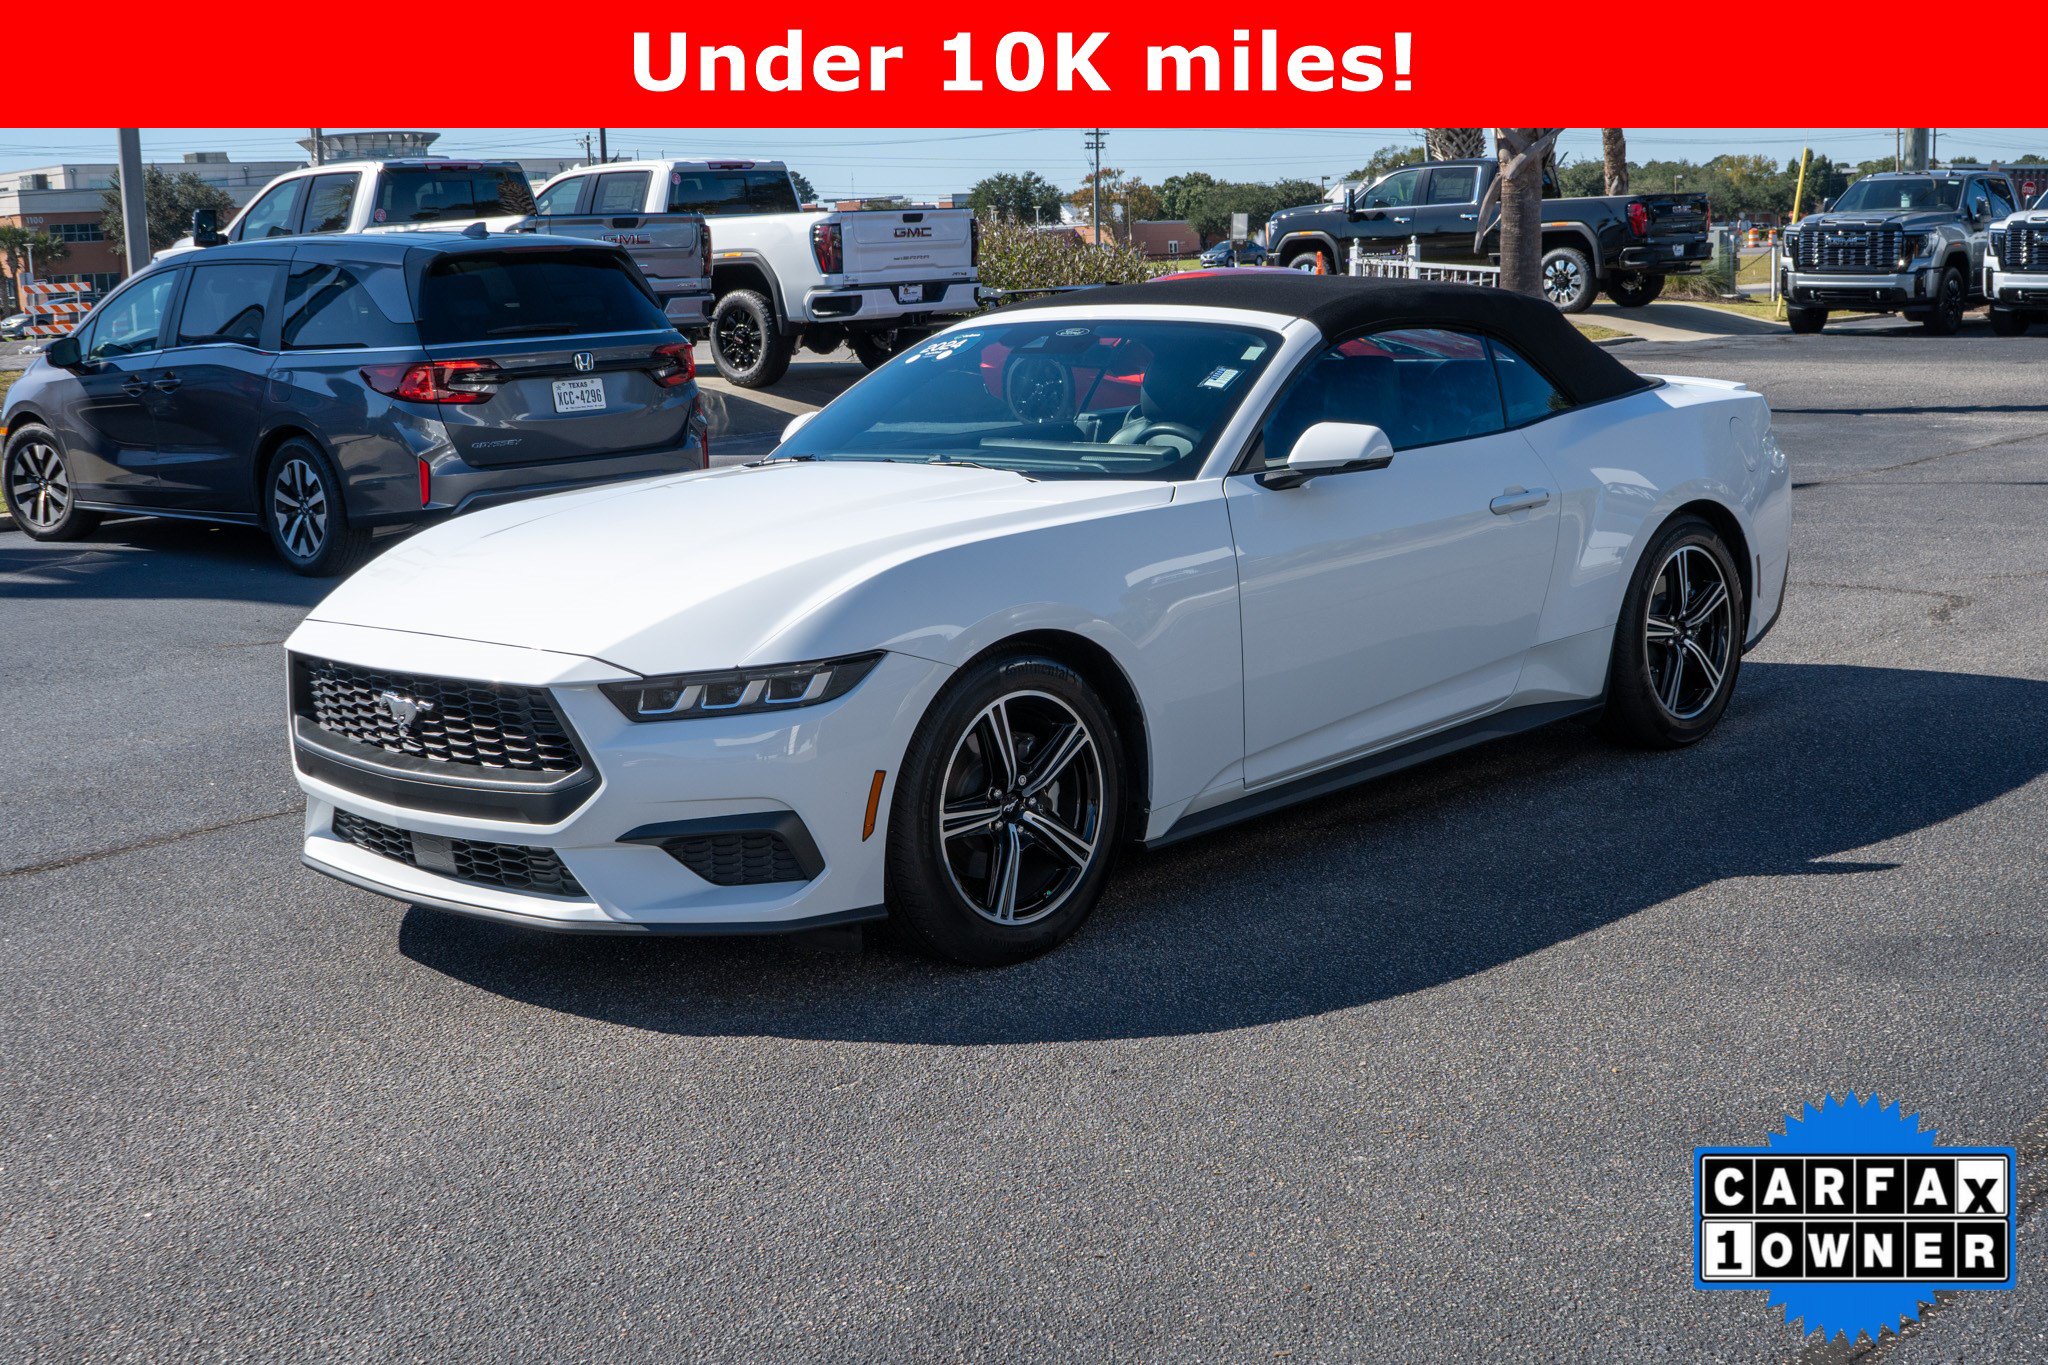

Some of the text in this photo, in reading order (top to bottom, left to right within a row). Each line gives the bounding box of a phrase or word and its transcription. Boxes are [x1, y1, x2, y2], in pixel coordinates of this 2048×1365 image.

[893, 227, 932, 238] GMC
[602, 233, 651, 245] GMC
[568, 381, 588, 389] TEXAS
